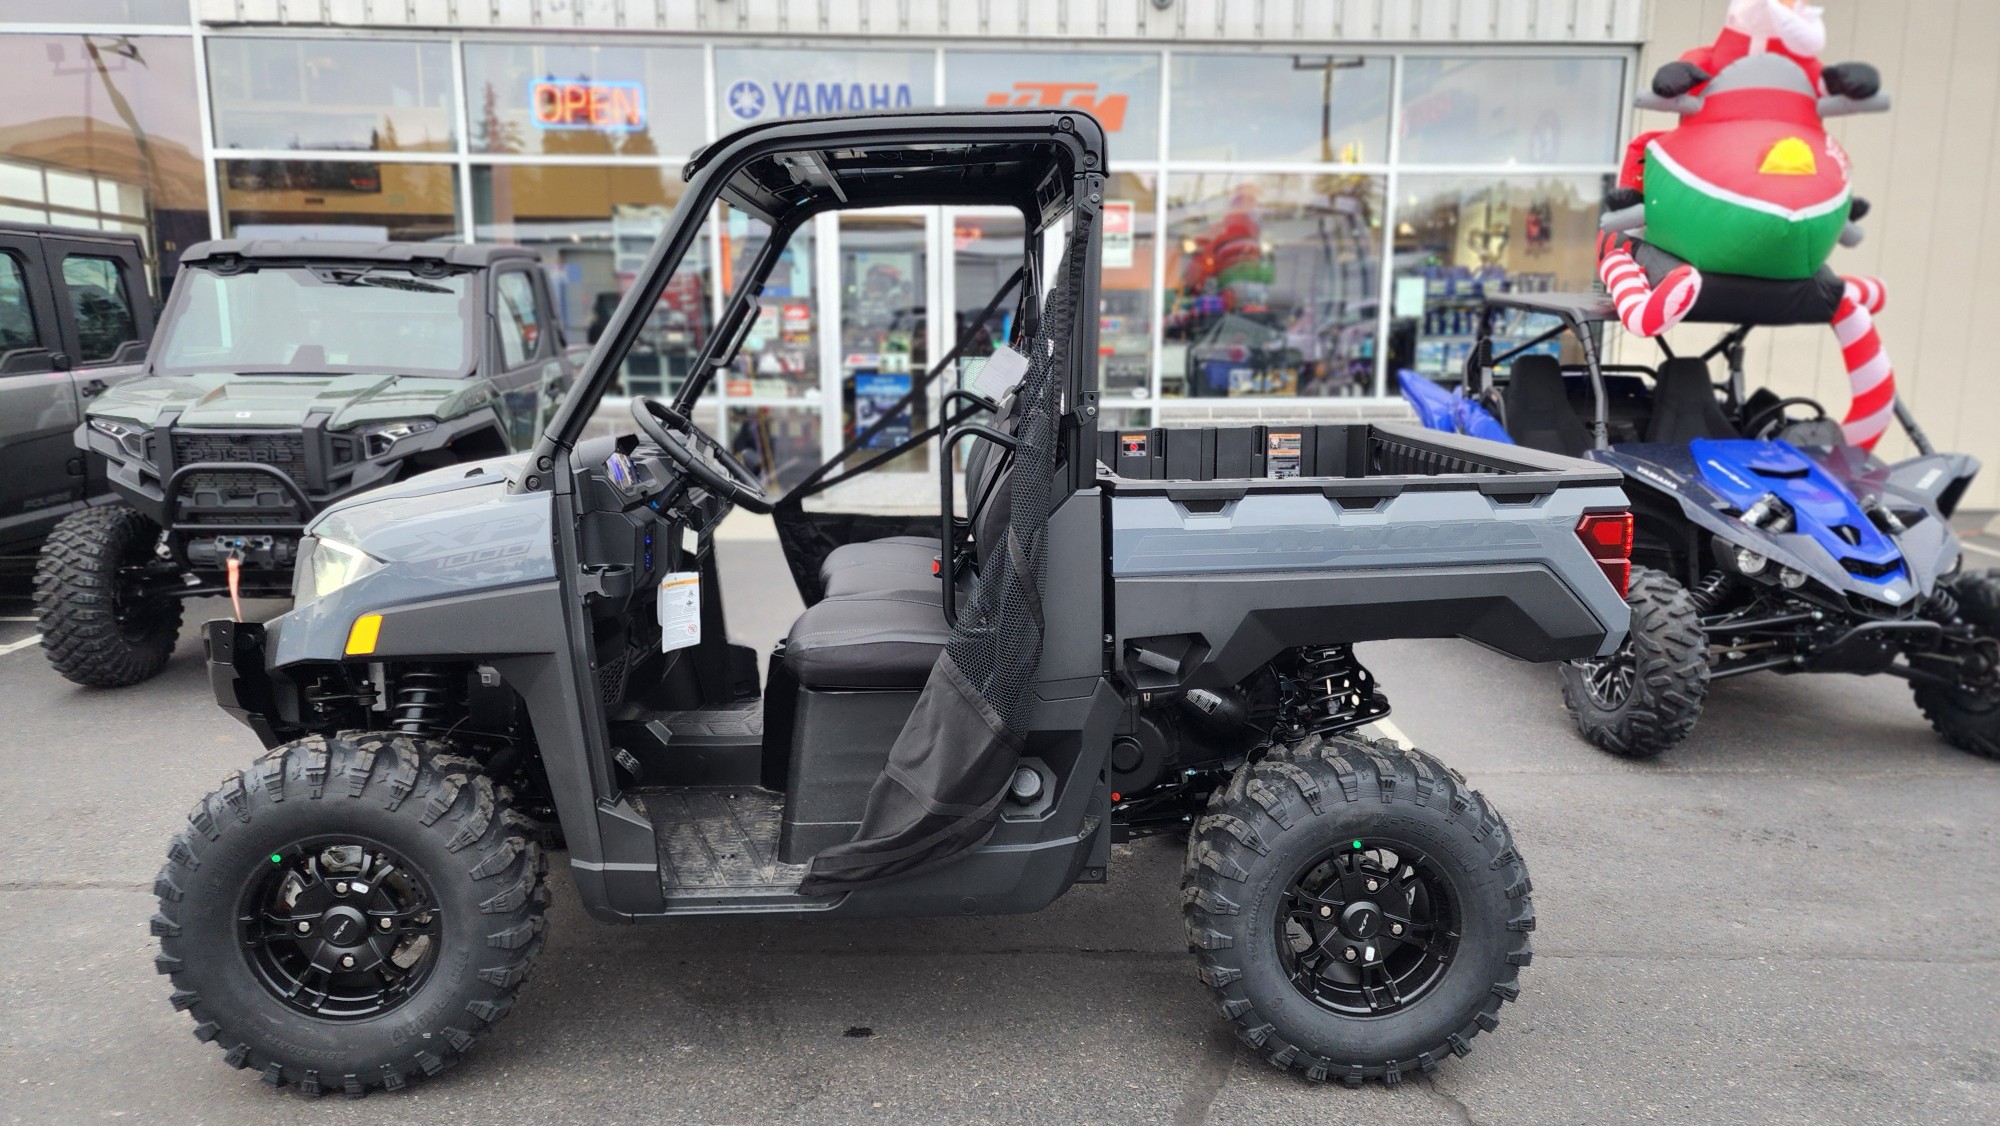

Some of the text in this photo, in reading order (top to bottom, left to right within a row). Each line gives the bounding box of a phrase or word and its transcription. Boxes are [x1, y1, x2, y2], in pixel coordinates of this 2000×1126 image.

[533, 82, 642, 127] OPEN
[772, 81, 912, 117] YAMAHA
[187, 446, 293, 463] POLARIS
[1636, 465, 1678, 490] YAMAHA
[435, 540, 534, 571] 1000
